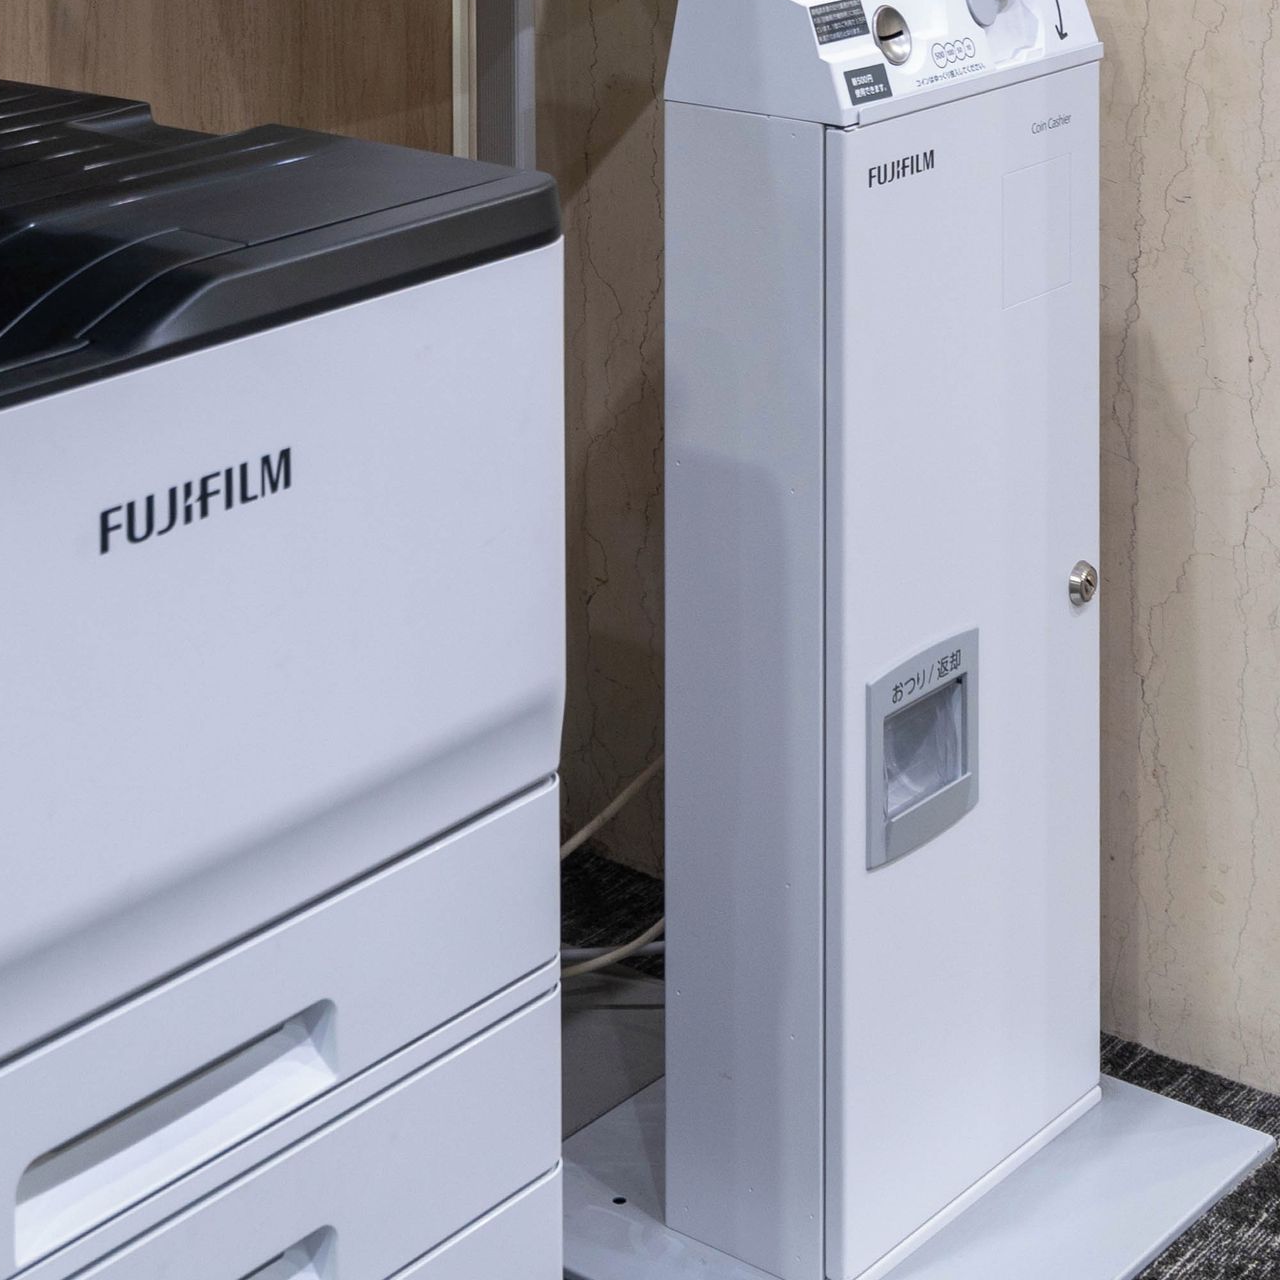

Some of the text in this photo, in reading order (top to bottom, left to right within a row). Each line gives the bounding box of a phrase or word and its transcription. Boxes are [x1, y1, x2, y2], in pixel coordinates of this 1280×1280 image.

[934, 51, 945, 60] 500
[1031, 114, 1072, 134] Coin Cashier
[869, 149, 934, 188] FUJIFILM
[99, 447, 292, 555] FUJIFILM
